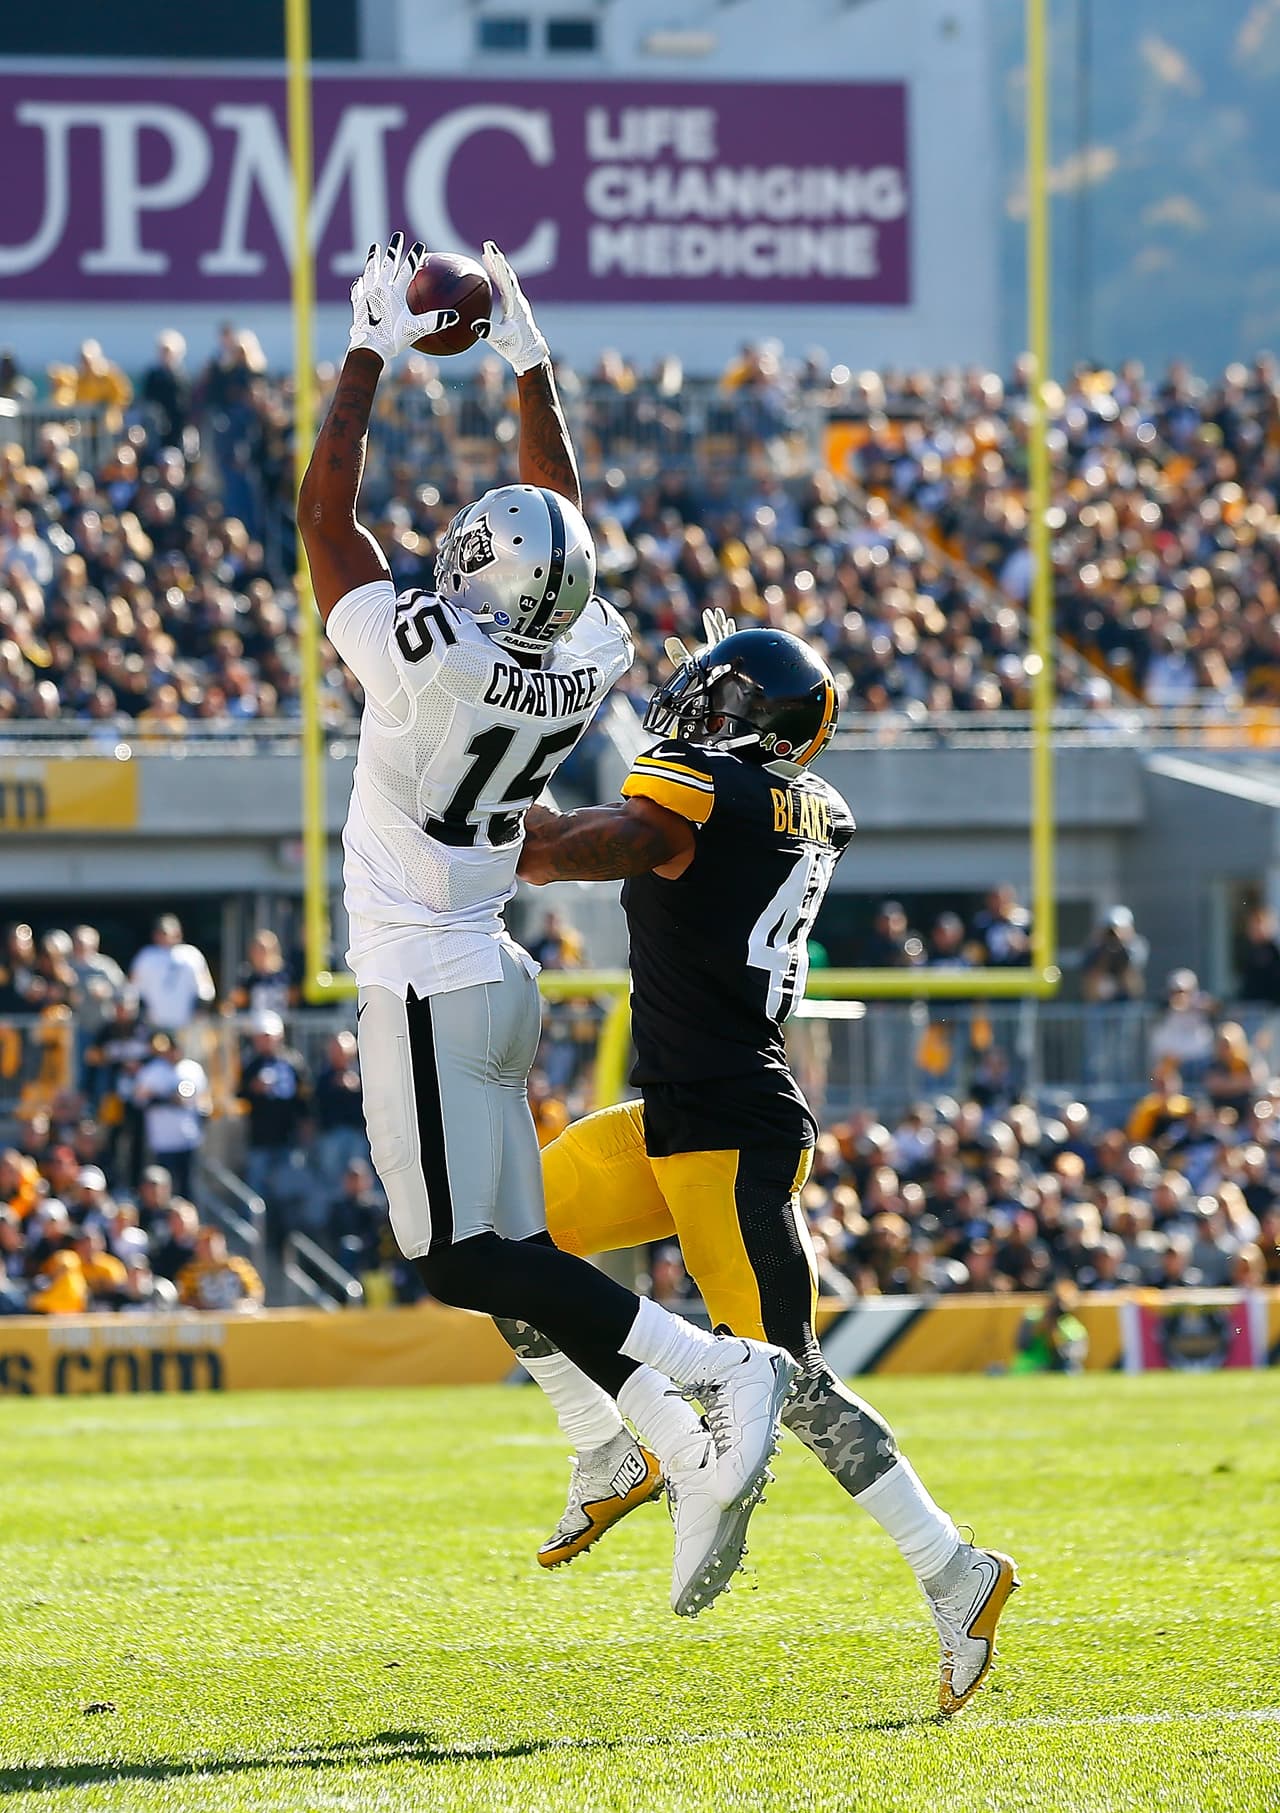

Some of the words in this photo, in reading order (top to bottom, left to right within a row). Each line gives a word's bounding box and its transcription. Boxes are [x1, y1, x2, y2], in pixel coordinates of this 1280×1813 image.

[587, 107, 717, 161] LIFE
[586, 165, 904, 220] CHANGING
[589, 224, 878, 278] MEDICINE
[521, 599, 534, 608] AL
[483, 662, 599, 717] CRABTREE
[424, 722, 585, 847] 15
[770, 788, 831, 843] BLAKE
[611, 1453, 644, 1500] NIKE
